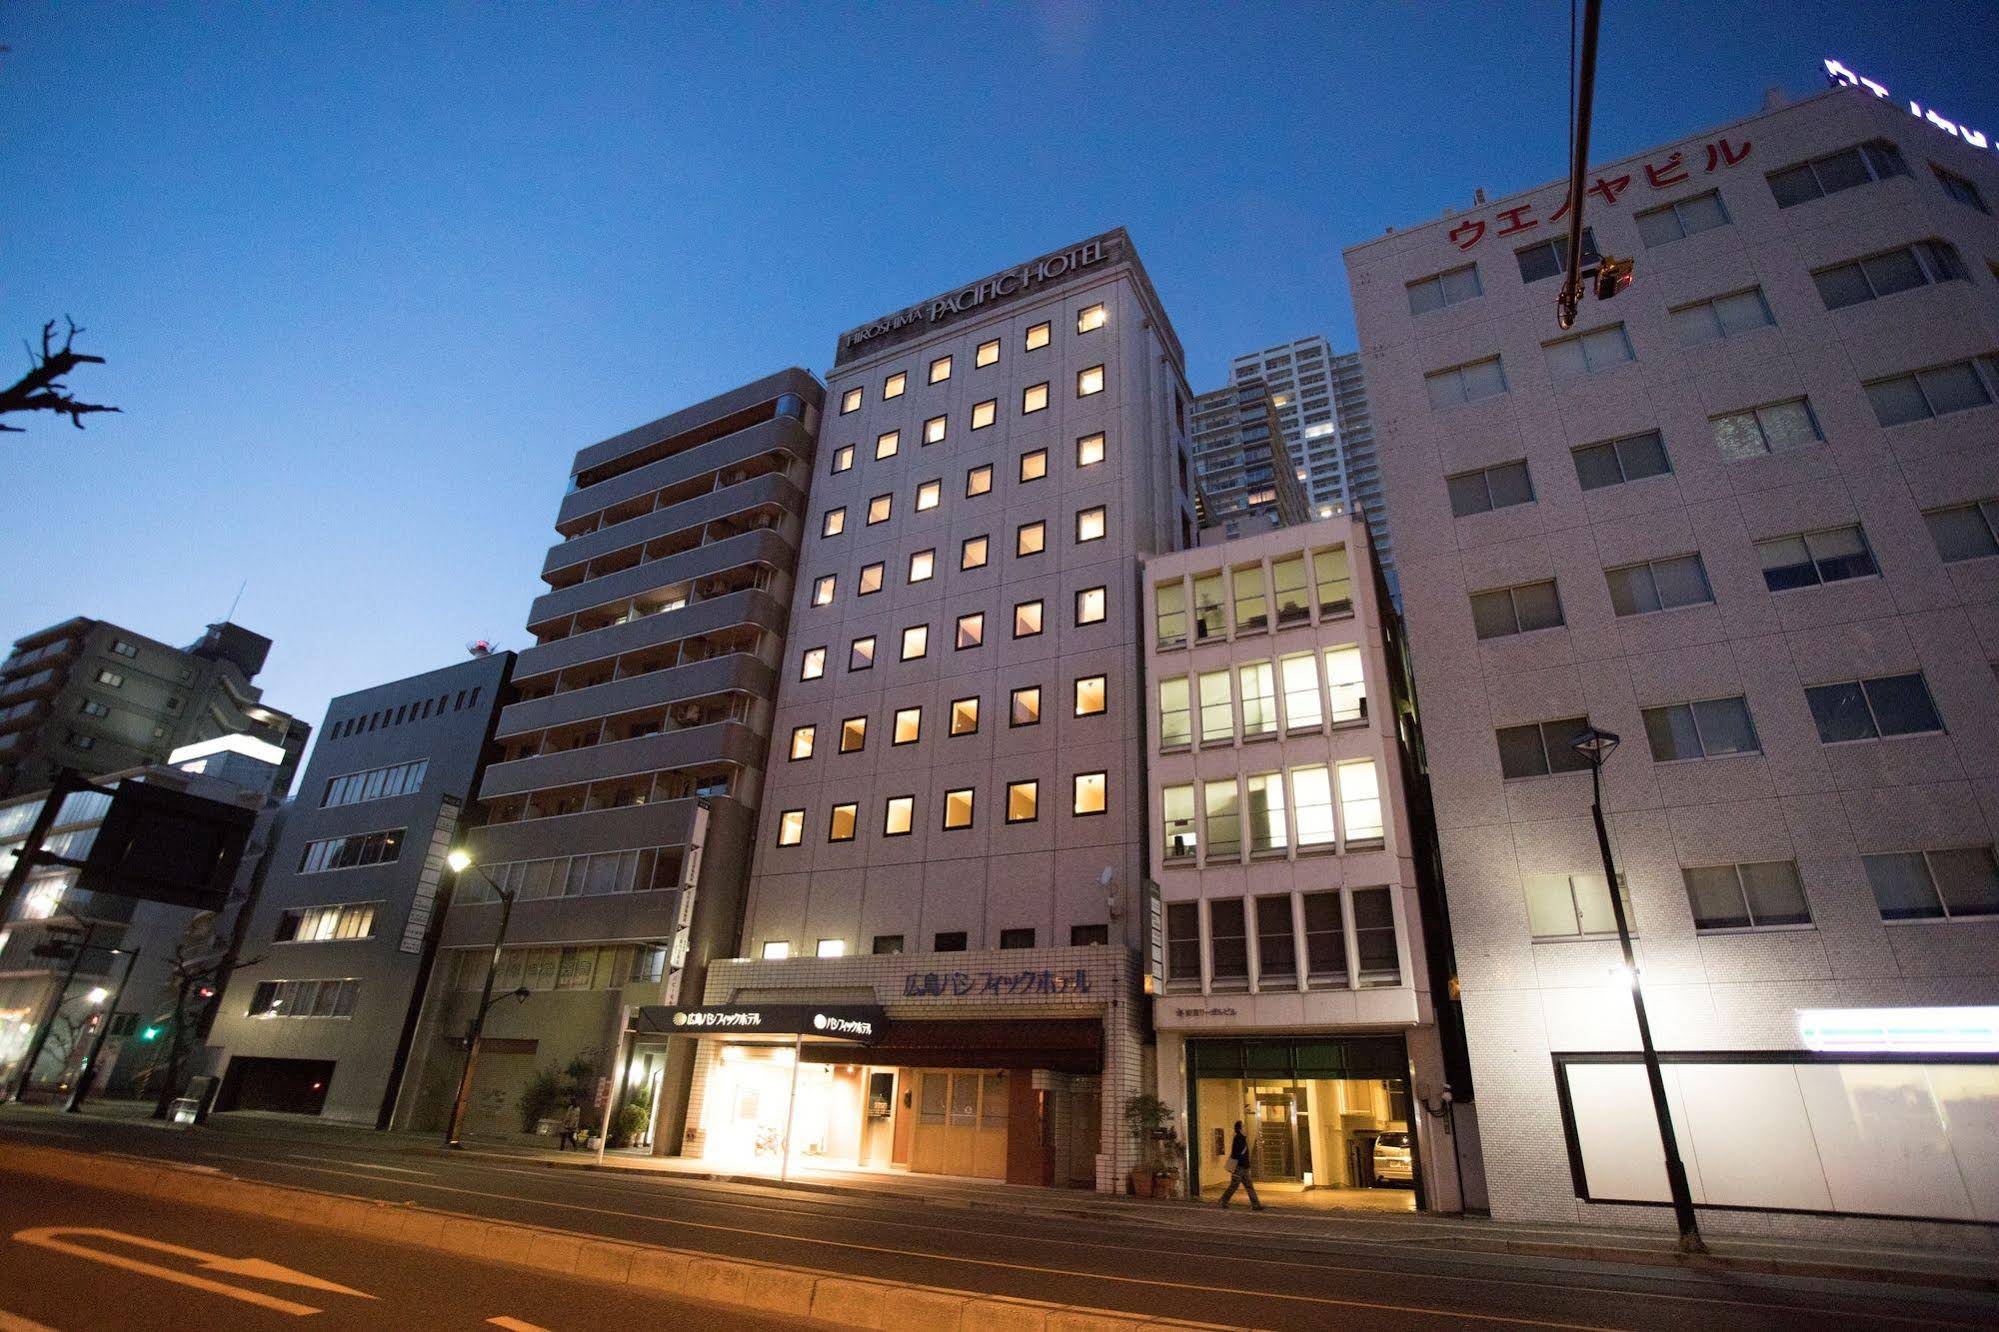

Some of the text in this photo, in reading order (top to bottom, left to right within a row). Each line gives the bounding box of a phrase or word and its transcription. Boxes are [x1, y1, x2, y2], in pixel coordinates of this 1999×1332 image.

[1450, 138, 1751, 251] ウエノヤビル
[847, 241, 1107, 348] HIROSHIMA PACIFIC HOTEL
